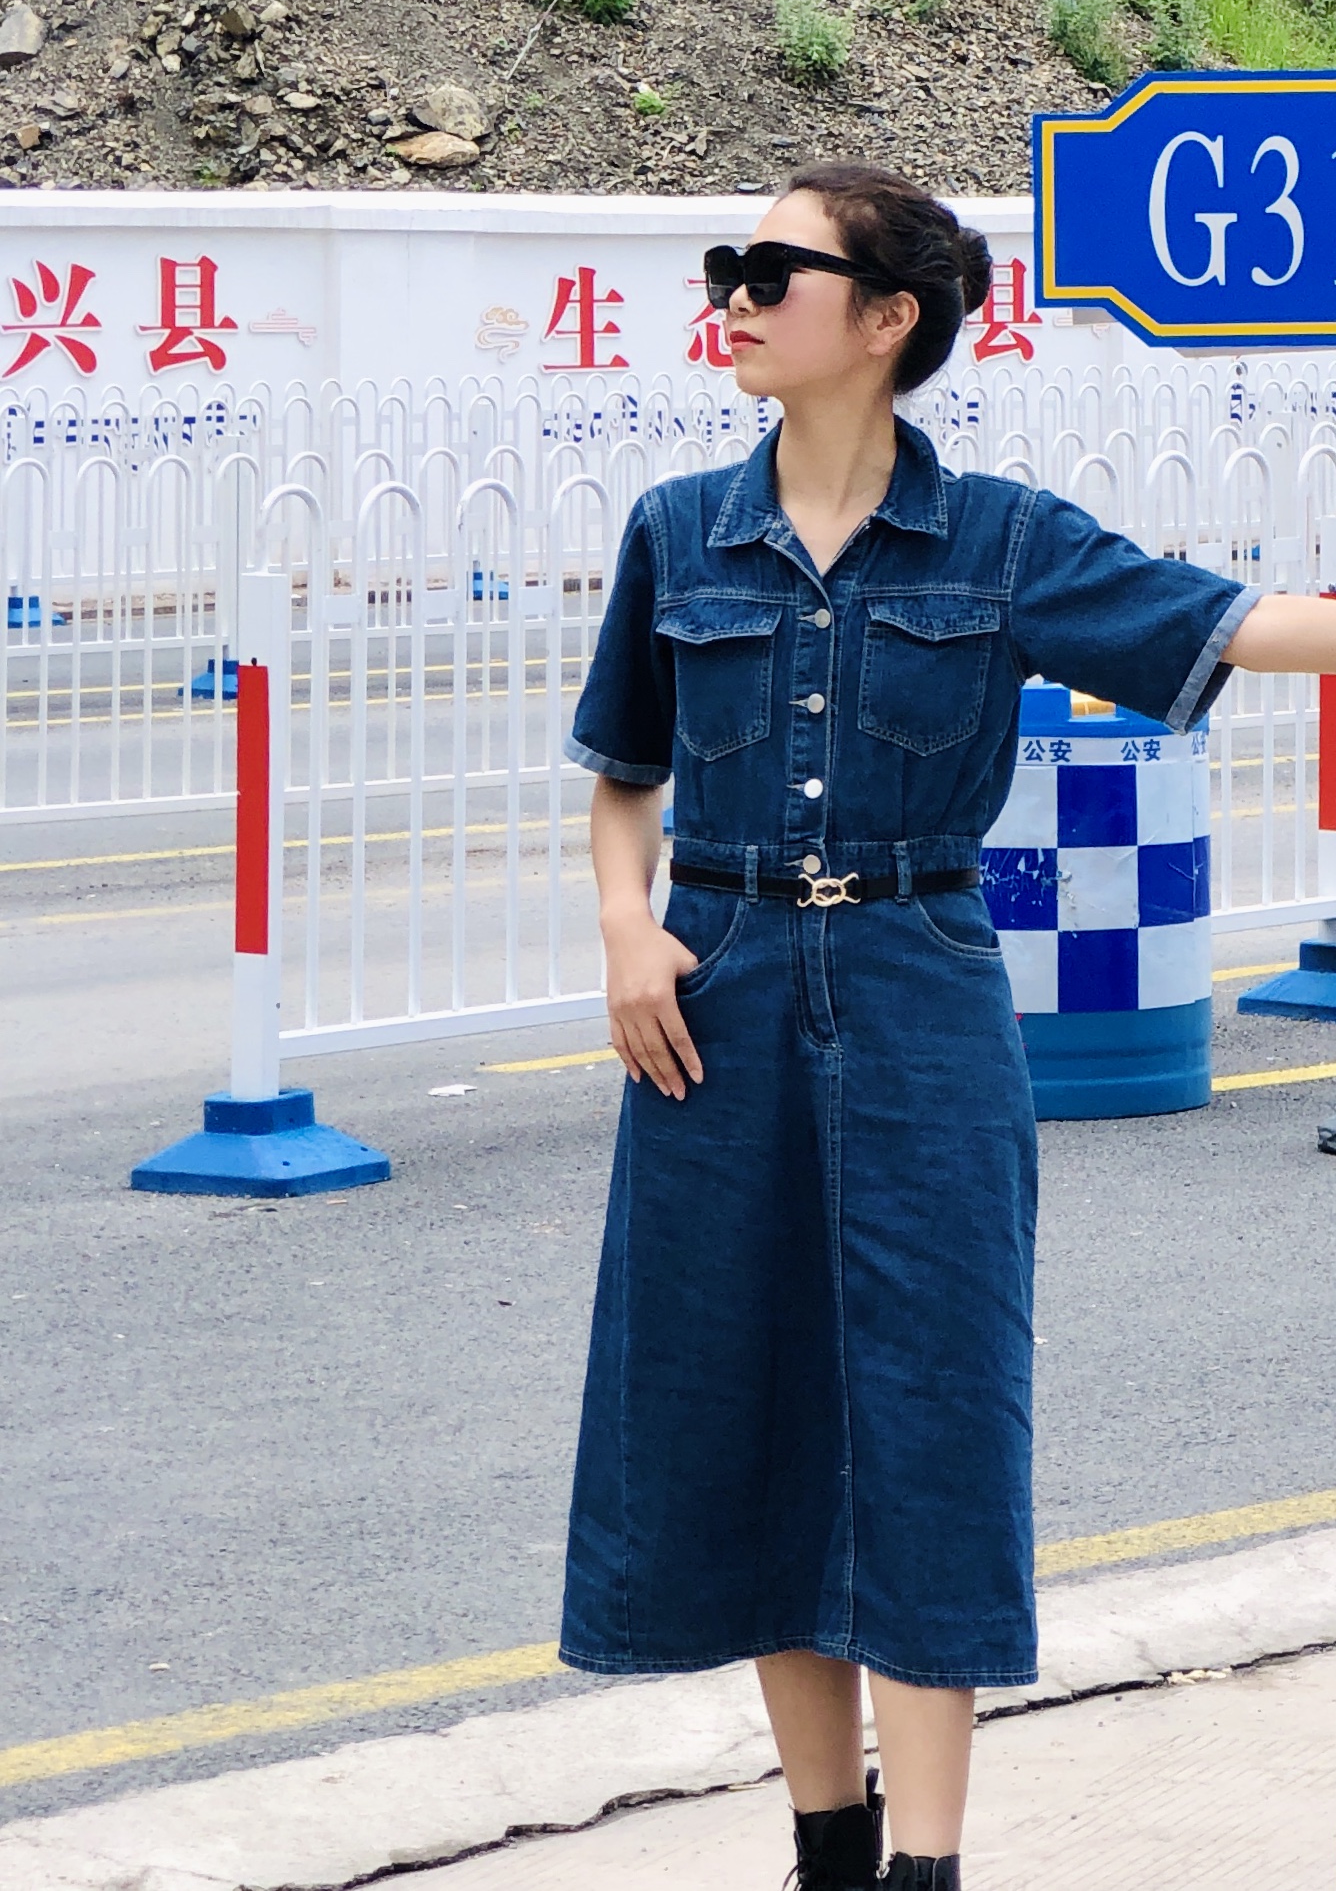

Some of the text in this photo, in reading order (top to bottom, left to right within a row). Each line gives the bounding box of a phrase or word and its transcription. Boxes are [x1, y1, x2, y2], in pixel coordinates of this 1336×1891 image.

[1, 255, 240, 379] 兴县
[1023, 739, 1072, 763] 公安
[1120, 738, 1161, 761] 公安
